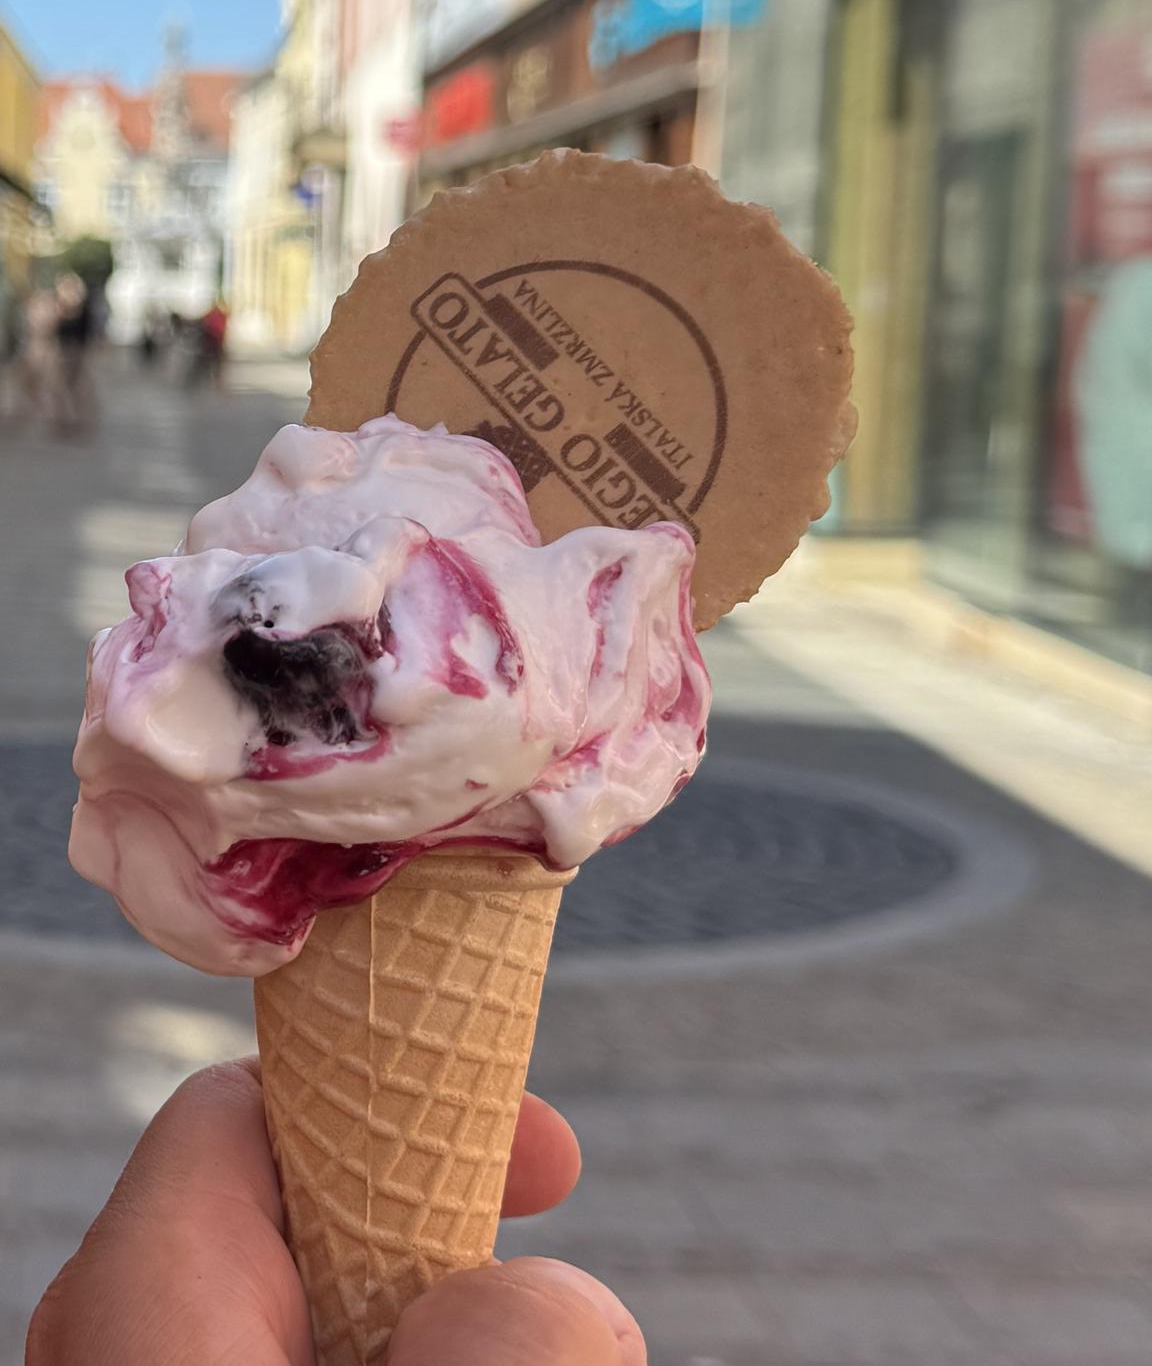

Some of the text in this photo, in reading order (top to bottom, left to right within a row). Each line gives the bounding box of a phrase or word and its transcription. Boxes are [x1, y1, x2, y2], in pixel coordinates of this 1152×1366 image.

[428, 292, 668, 530] EGIO GELATO
[514, 278, 694, 470] ITALSKÁ ZMRZLINA
